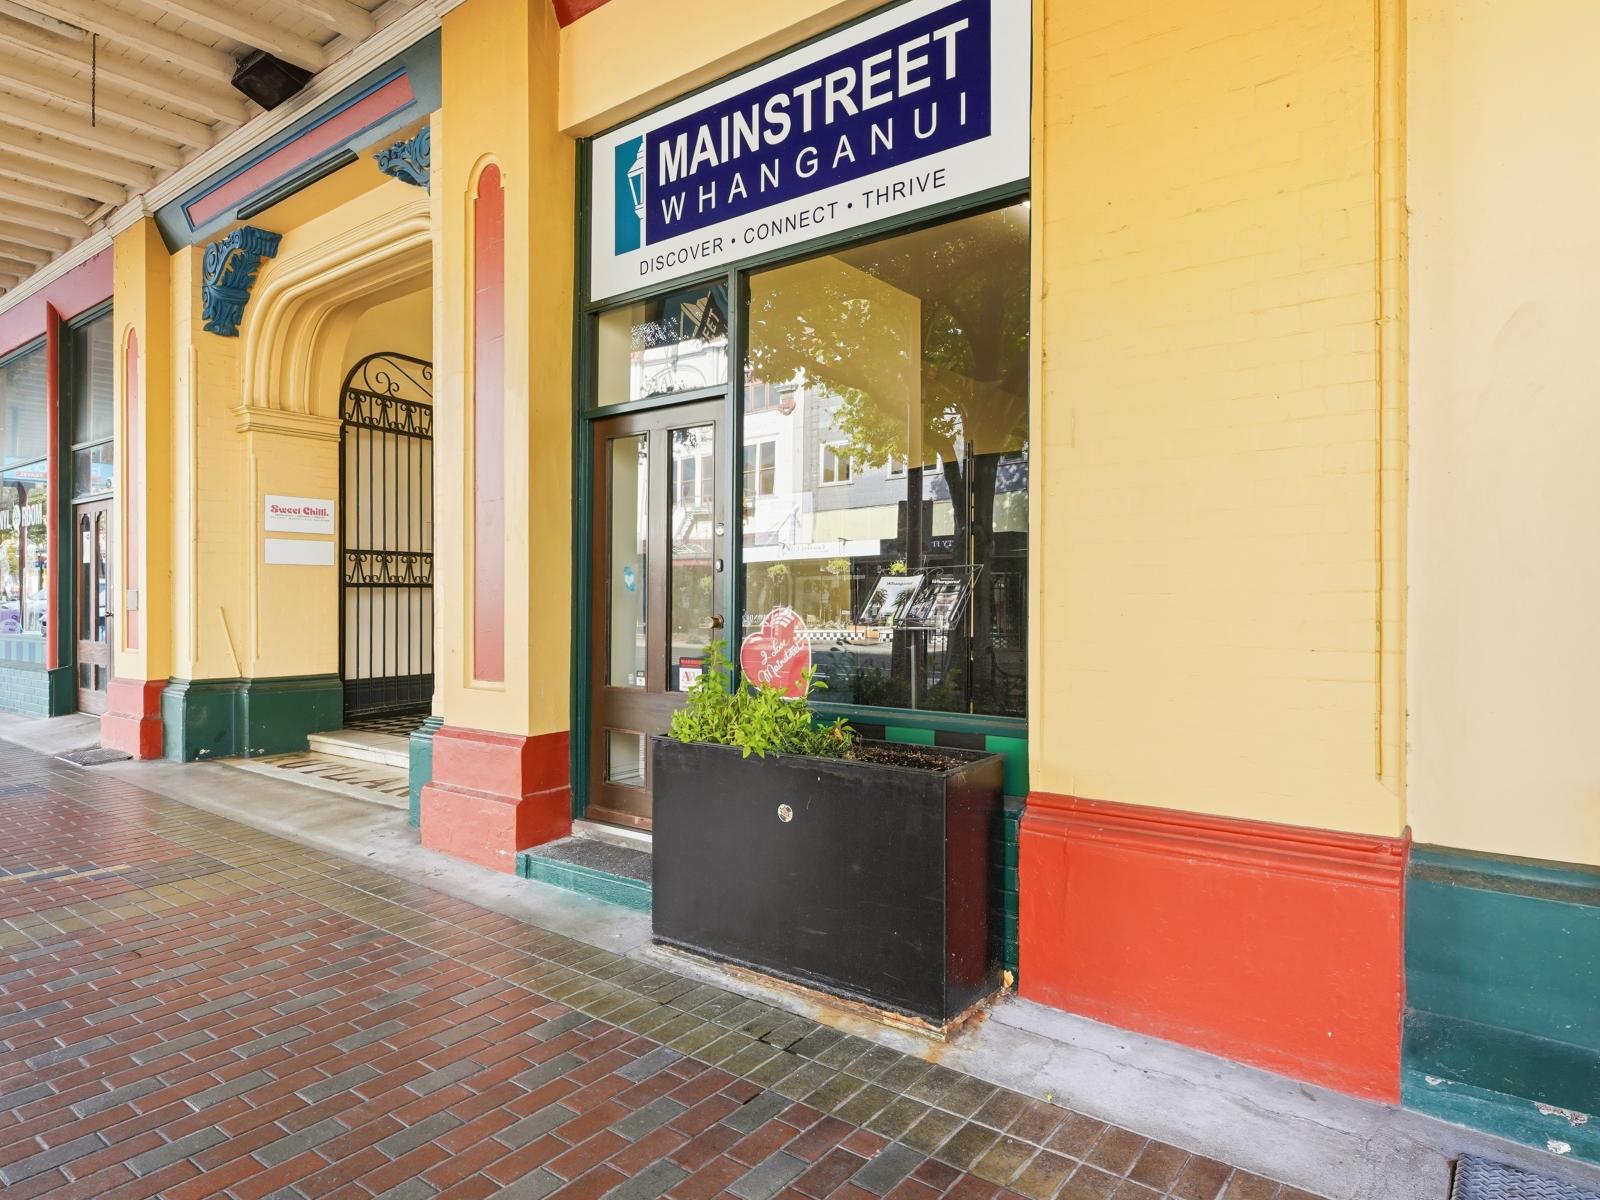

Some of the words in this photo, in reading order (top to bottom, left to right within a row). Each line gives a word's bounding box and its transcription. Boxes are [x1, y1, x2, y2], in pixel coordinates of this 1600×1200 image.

[658, 18, 969, 187] MAINSTREET
[661, 92, 967, 225] WHANGANUI
[639, 237, 724, 276] DISCOVER
[743, 201, 839, 245] CONNECT
[862, 168, 947, 210] THRIVE
[21, 503, 42, 527] ROOM
[270, 504, 301, 515] Sweet
